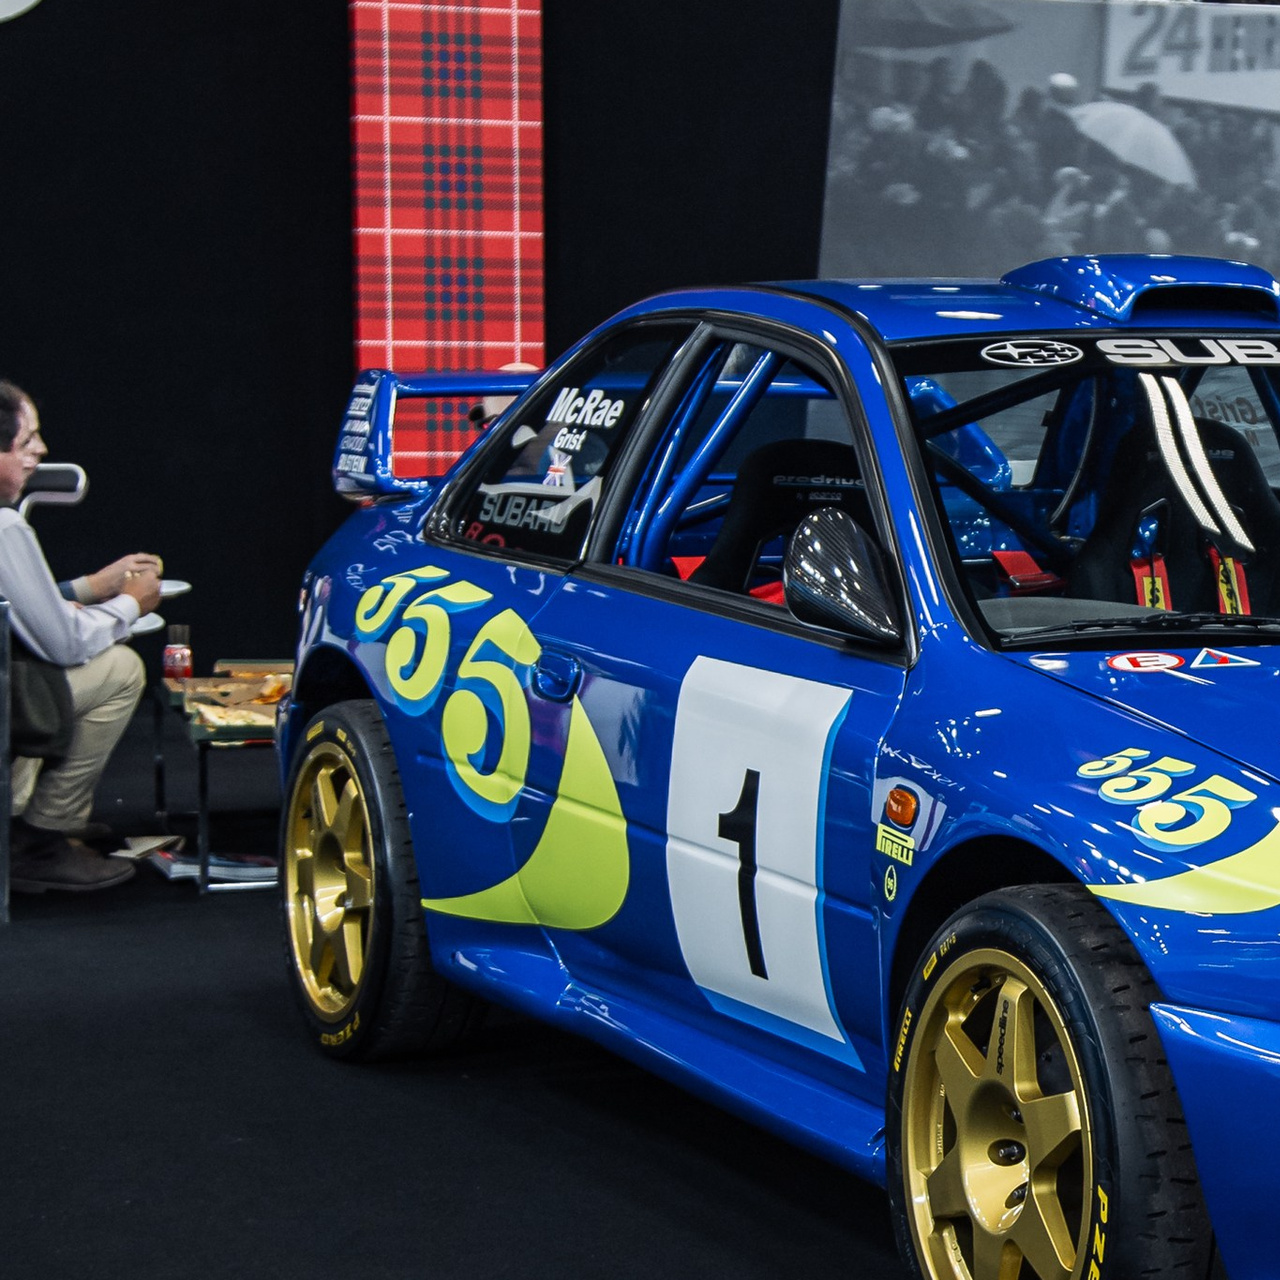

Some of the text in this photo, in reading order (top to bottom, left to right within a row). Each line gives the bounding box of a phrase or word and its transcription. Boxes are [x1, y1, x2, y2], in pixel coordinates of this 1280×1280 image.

[1121, 3, 1203, 75] 24
[545, 387, 625, 429] McRae
[553, 427, 588, 451] Grist
[355, 565, 541, 818] 555
[1077, 747, 1258, 851] 555
[718, 767, 769, 981] 1
[876, 822, 916, 867] PIRELLI
